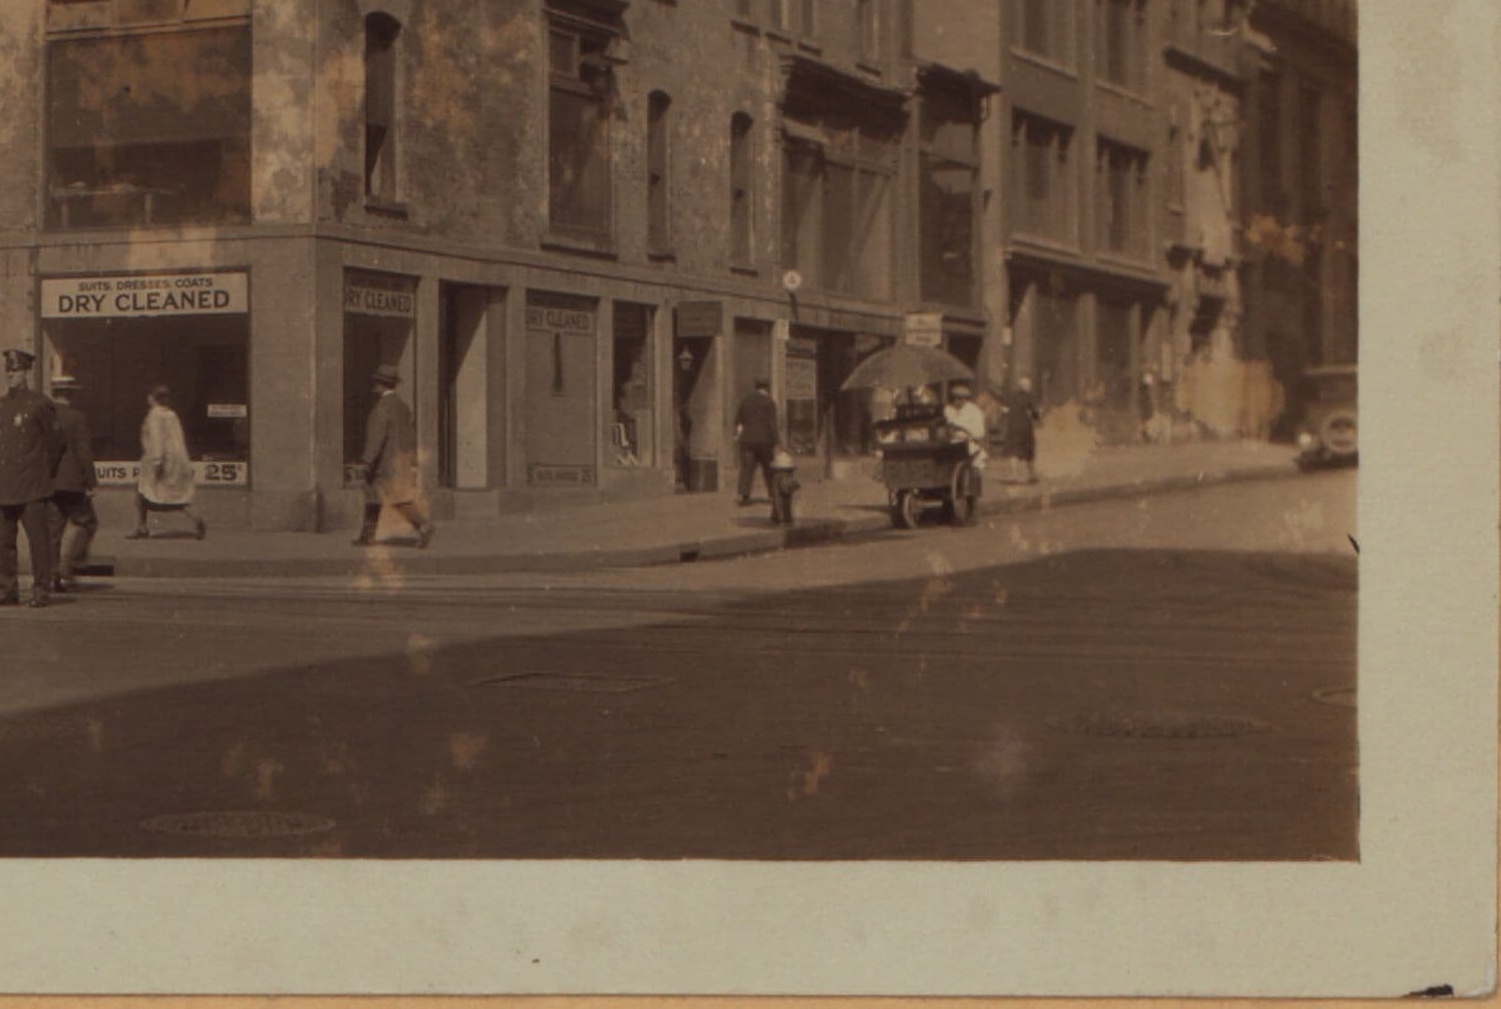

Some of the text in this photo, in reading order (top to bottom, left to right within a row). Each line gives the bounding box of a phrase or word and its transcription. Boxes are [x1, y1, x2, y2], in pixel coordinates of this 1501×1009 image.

[174, 277, 213, 288] COATS
[58, 290, 230, 313] DRY CLEANED
[364, 291, 411, 313] CLEANED
[96, 467, 126, 479] UITS
